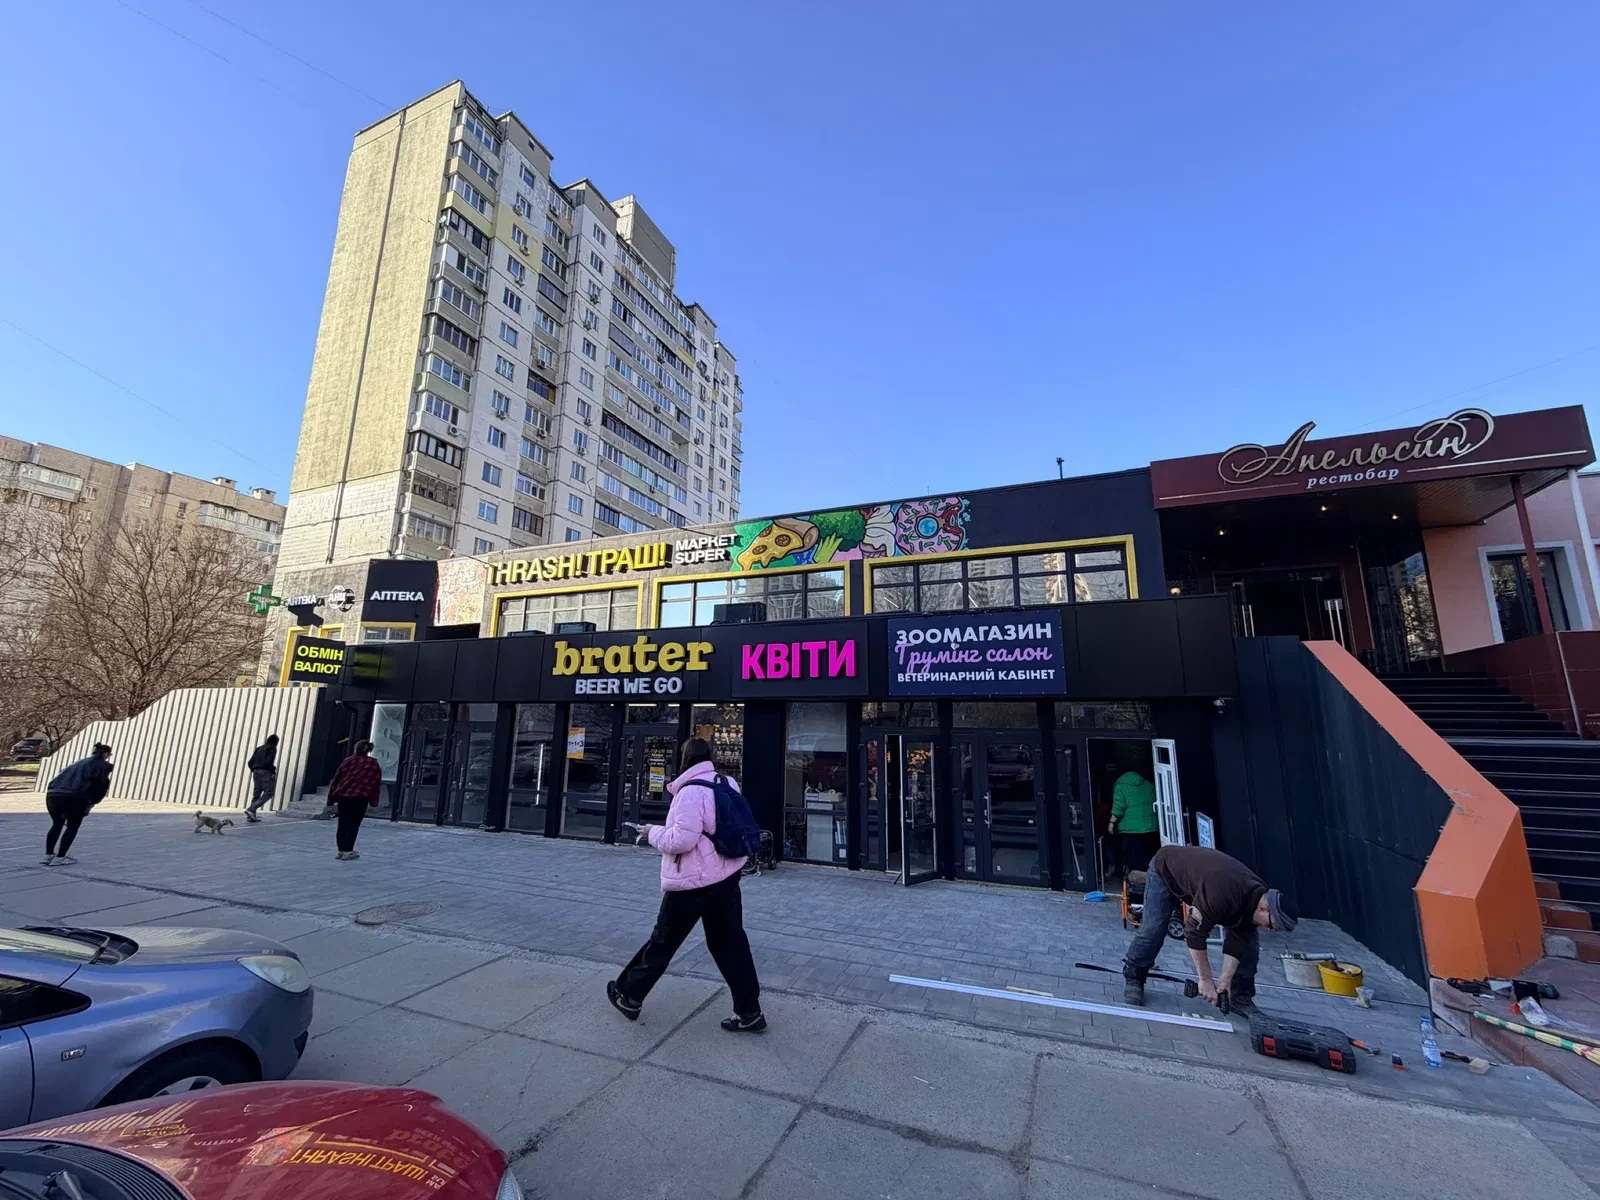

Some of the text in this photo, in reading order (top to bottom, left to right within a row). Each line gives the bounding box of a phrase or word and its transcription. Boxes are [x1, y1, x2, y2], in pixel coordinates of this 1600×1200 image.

[1218, 408, 1495, 484] Апельсин
[1306, 468, 1400, 489] рестобар
[675, 534, 737, 551] МАРКЕТ
[674, 549, 725, 565] SUPER
[370, 590, 424, 601] АПТЕКА
[896, 623, 1053, 646] ЗООМАГАЗИН
[297, 645, 343, 661] ОБМІН
[552, 635, 714, 676] brater
[741, 640, 856, 680] КВІТИ
[986, 645, 1053, 663] салон
[294, 661, 341, 675] ВАЛЮТ
[897, 668, 1055, 683] ВЕТЕРИНАРНИЙ КАБІНЕТ
[575, 677, 683, 694] BEER WE GO
